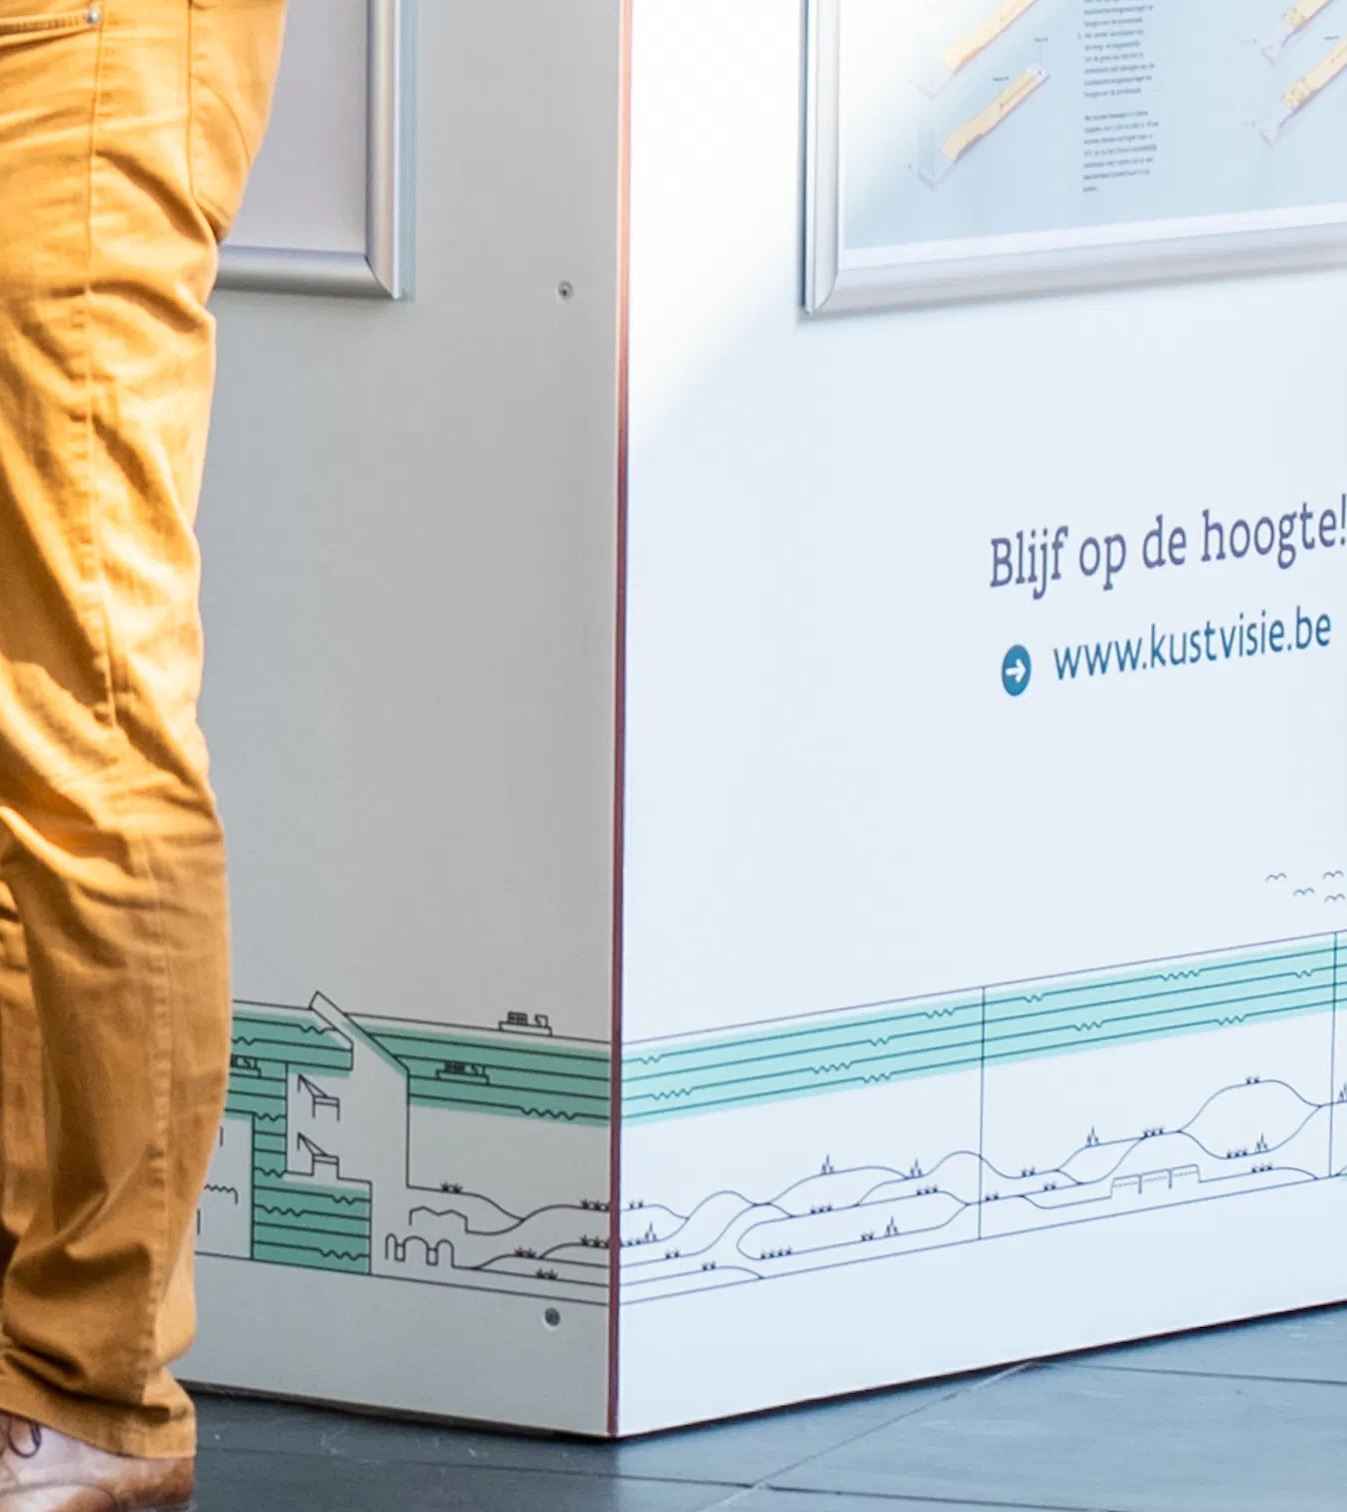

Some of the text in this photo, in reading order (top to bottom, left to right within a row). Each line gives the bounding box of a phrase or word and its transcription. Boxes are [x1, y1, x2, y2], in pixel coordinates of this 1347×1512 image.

[990, 493, 1347, 600] Blijf op de hoogte!
[1053, 605, 1331, 680] www.kustvisie.be
